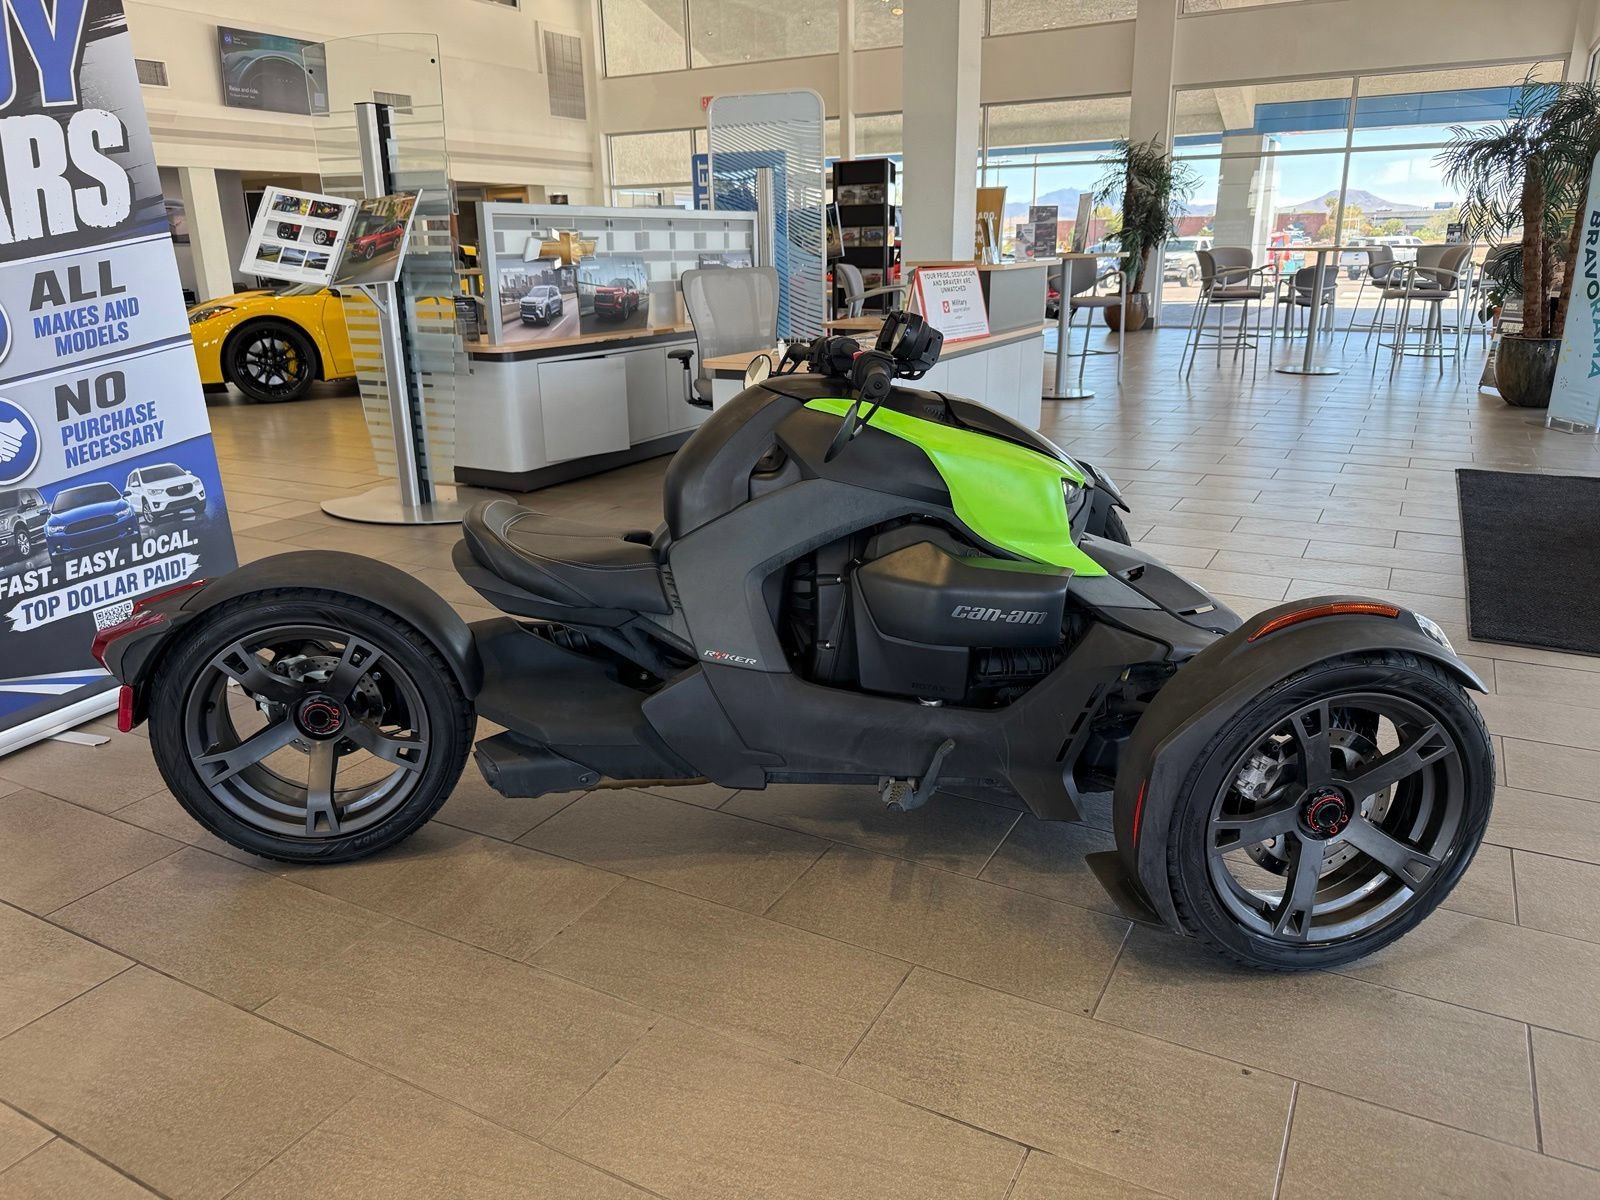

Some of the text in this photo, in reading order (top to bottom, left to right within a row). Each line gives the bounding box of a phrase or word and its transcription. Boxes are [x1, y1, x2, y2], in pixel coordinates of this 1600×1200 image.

[0, 0, 88, 109] Y
[29, 260, 126, 311] ALL
[33, 297, 139, 339] MAKES AND
[55, 321, 129, 357] MODELS
[54, 371, 126, 422] NO
[61, 401, 157, 446] PURCHASE
[65, 420, 164, 469] NECESSARY
[0, 529, 199, 600] FAST. EASY. LOCAL.
[21, 557, 187, 625] TOP DOLLAR PAID!
[951, 605, 1048, 625] can-am
[704, 649, 757, 665] RYKER
